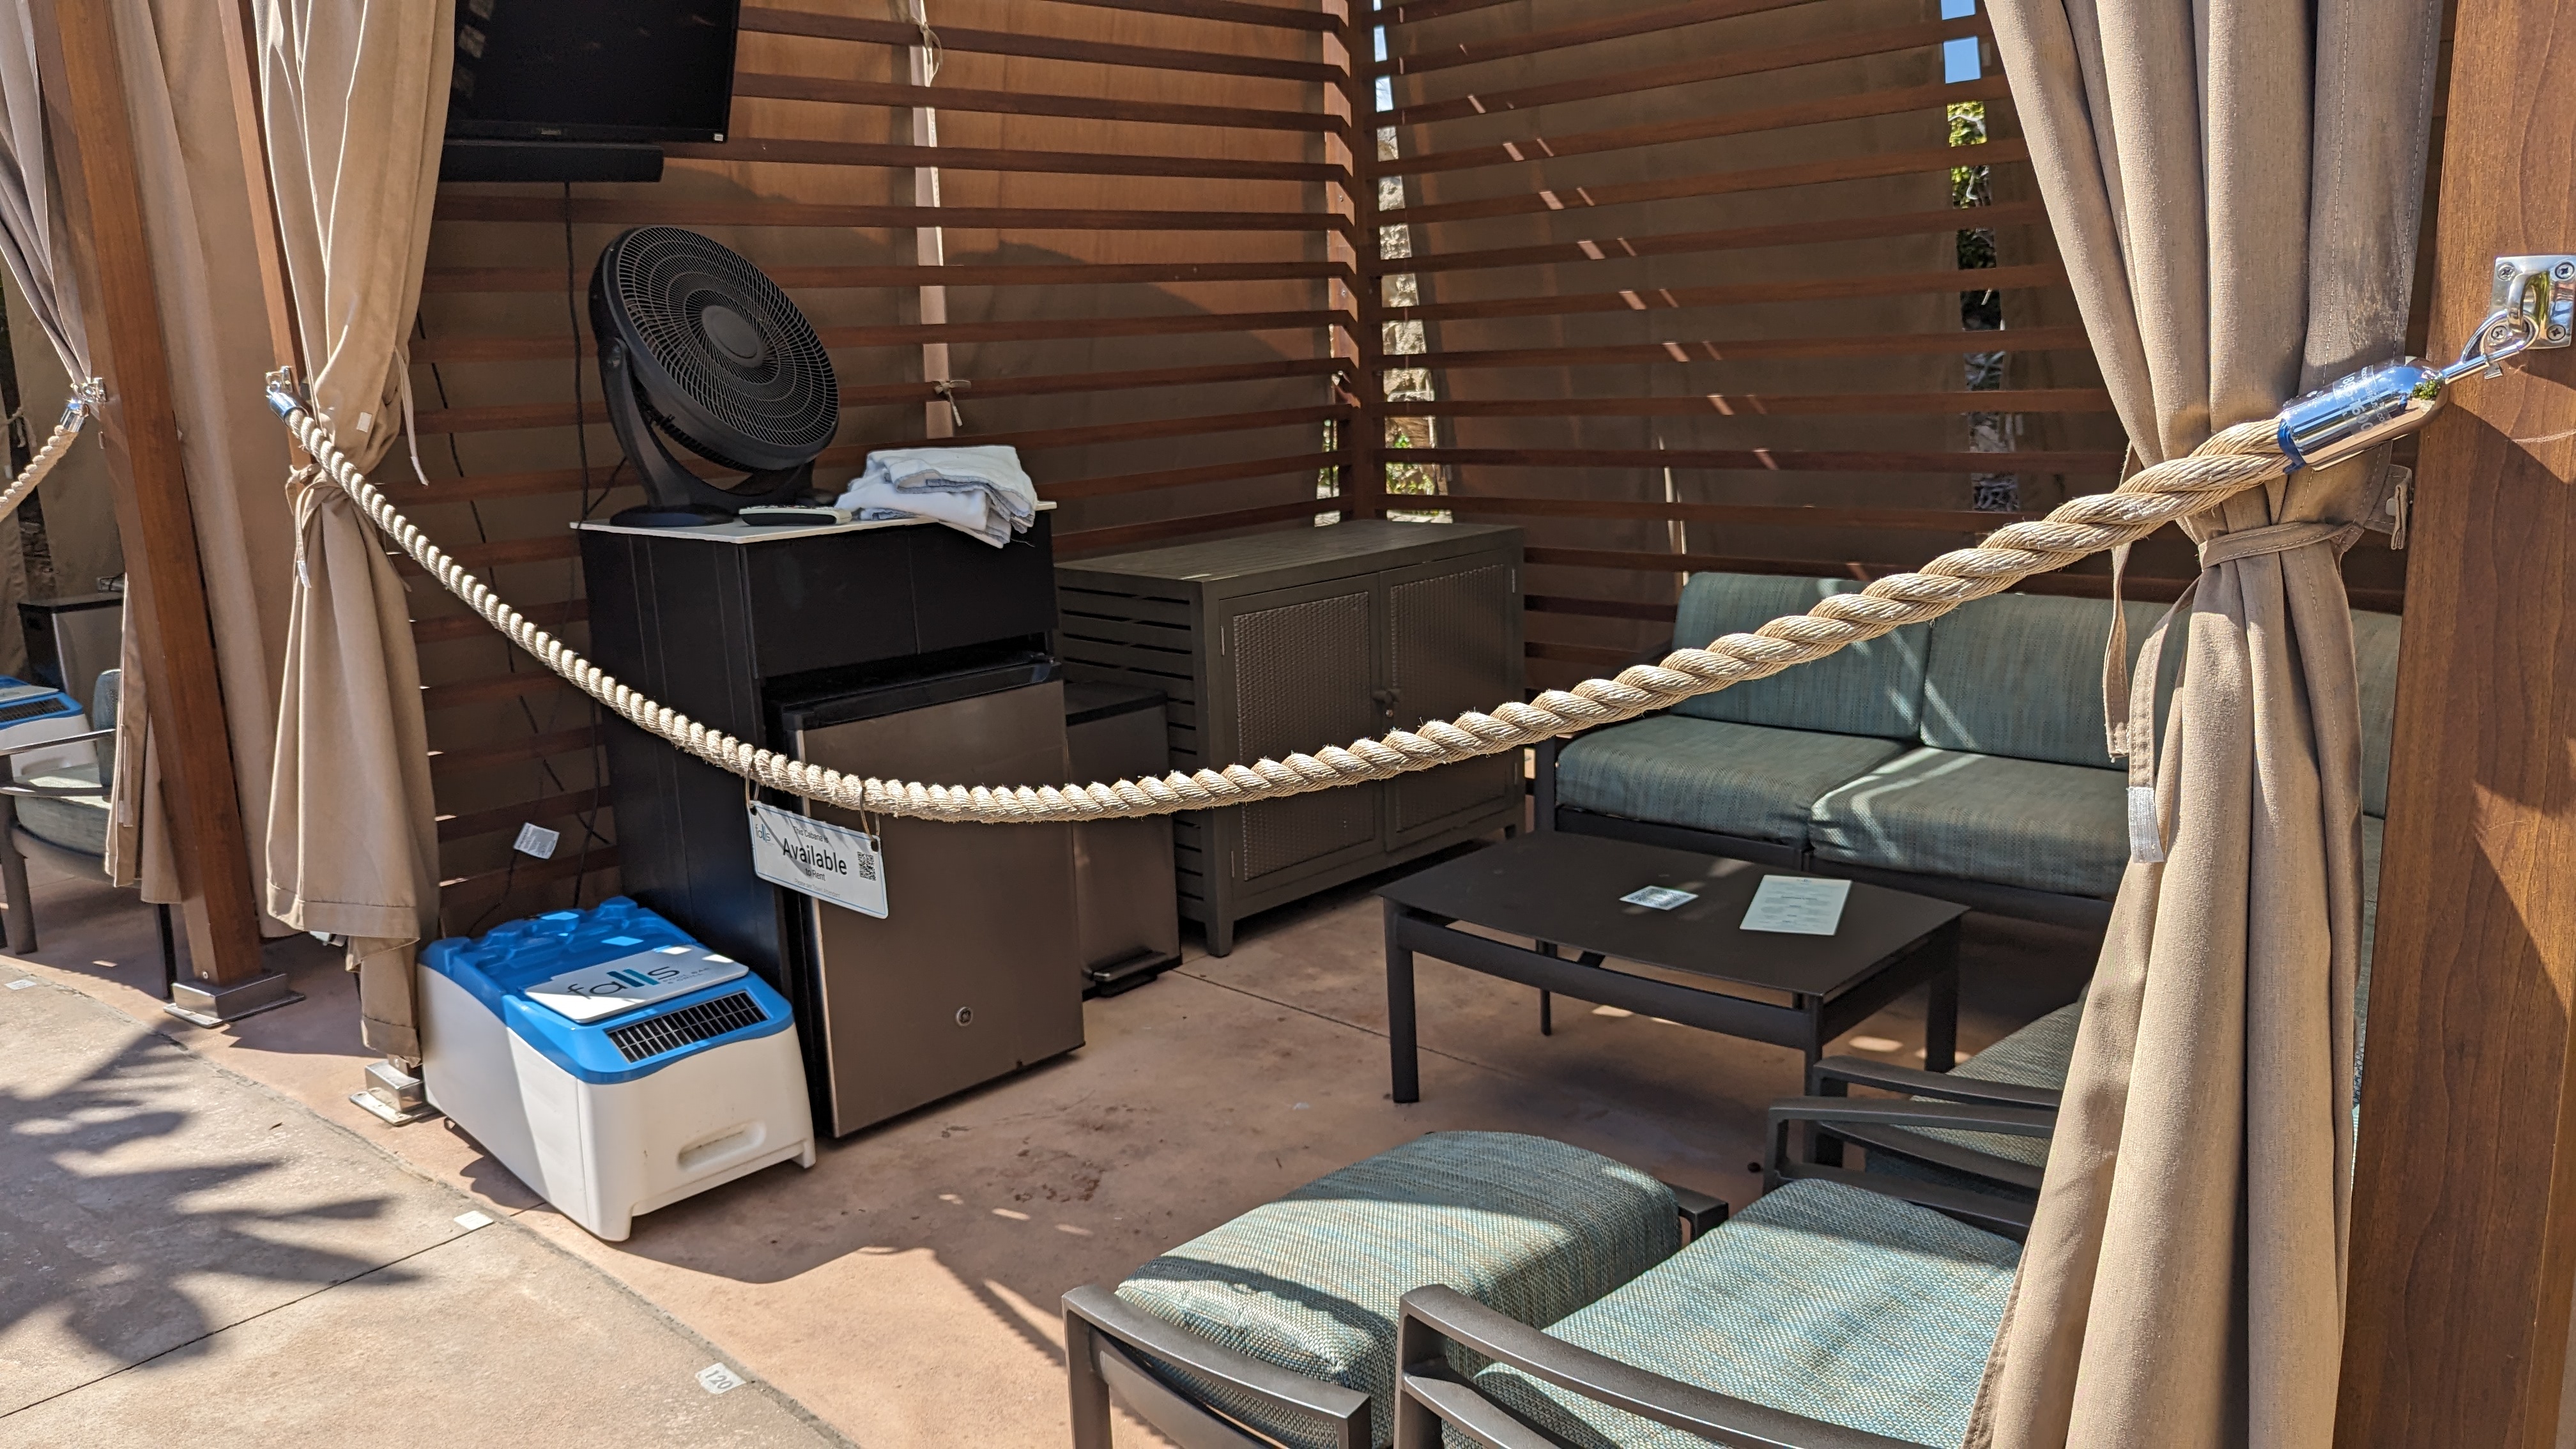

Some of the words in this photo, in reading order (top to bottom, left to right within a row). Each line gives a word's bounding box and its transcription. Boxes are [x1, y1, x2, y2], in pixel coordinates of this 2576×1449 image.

[755, 824, 770, 843] falls
[793, 825, 804, 836] This
[804, 829, 823, 841] Cabana
[783, 838, 847, 875] Available
[805, 868, 811, 877] to
[812, 869, 826, 881] Rent
[567, 967, 680, 999] falls
[705, 1369, 734, 1390] 120
